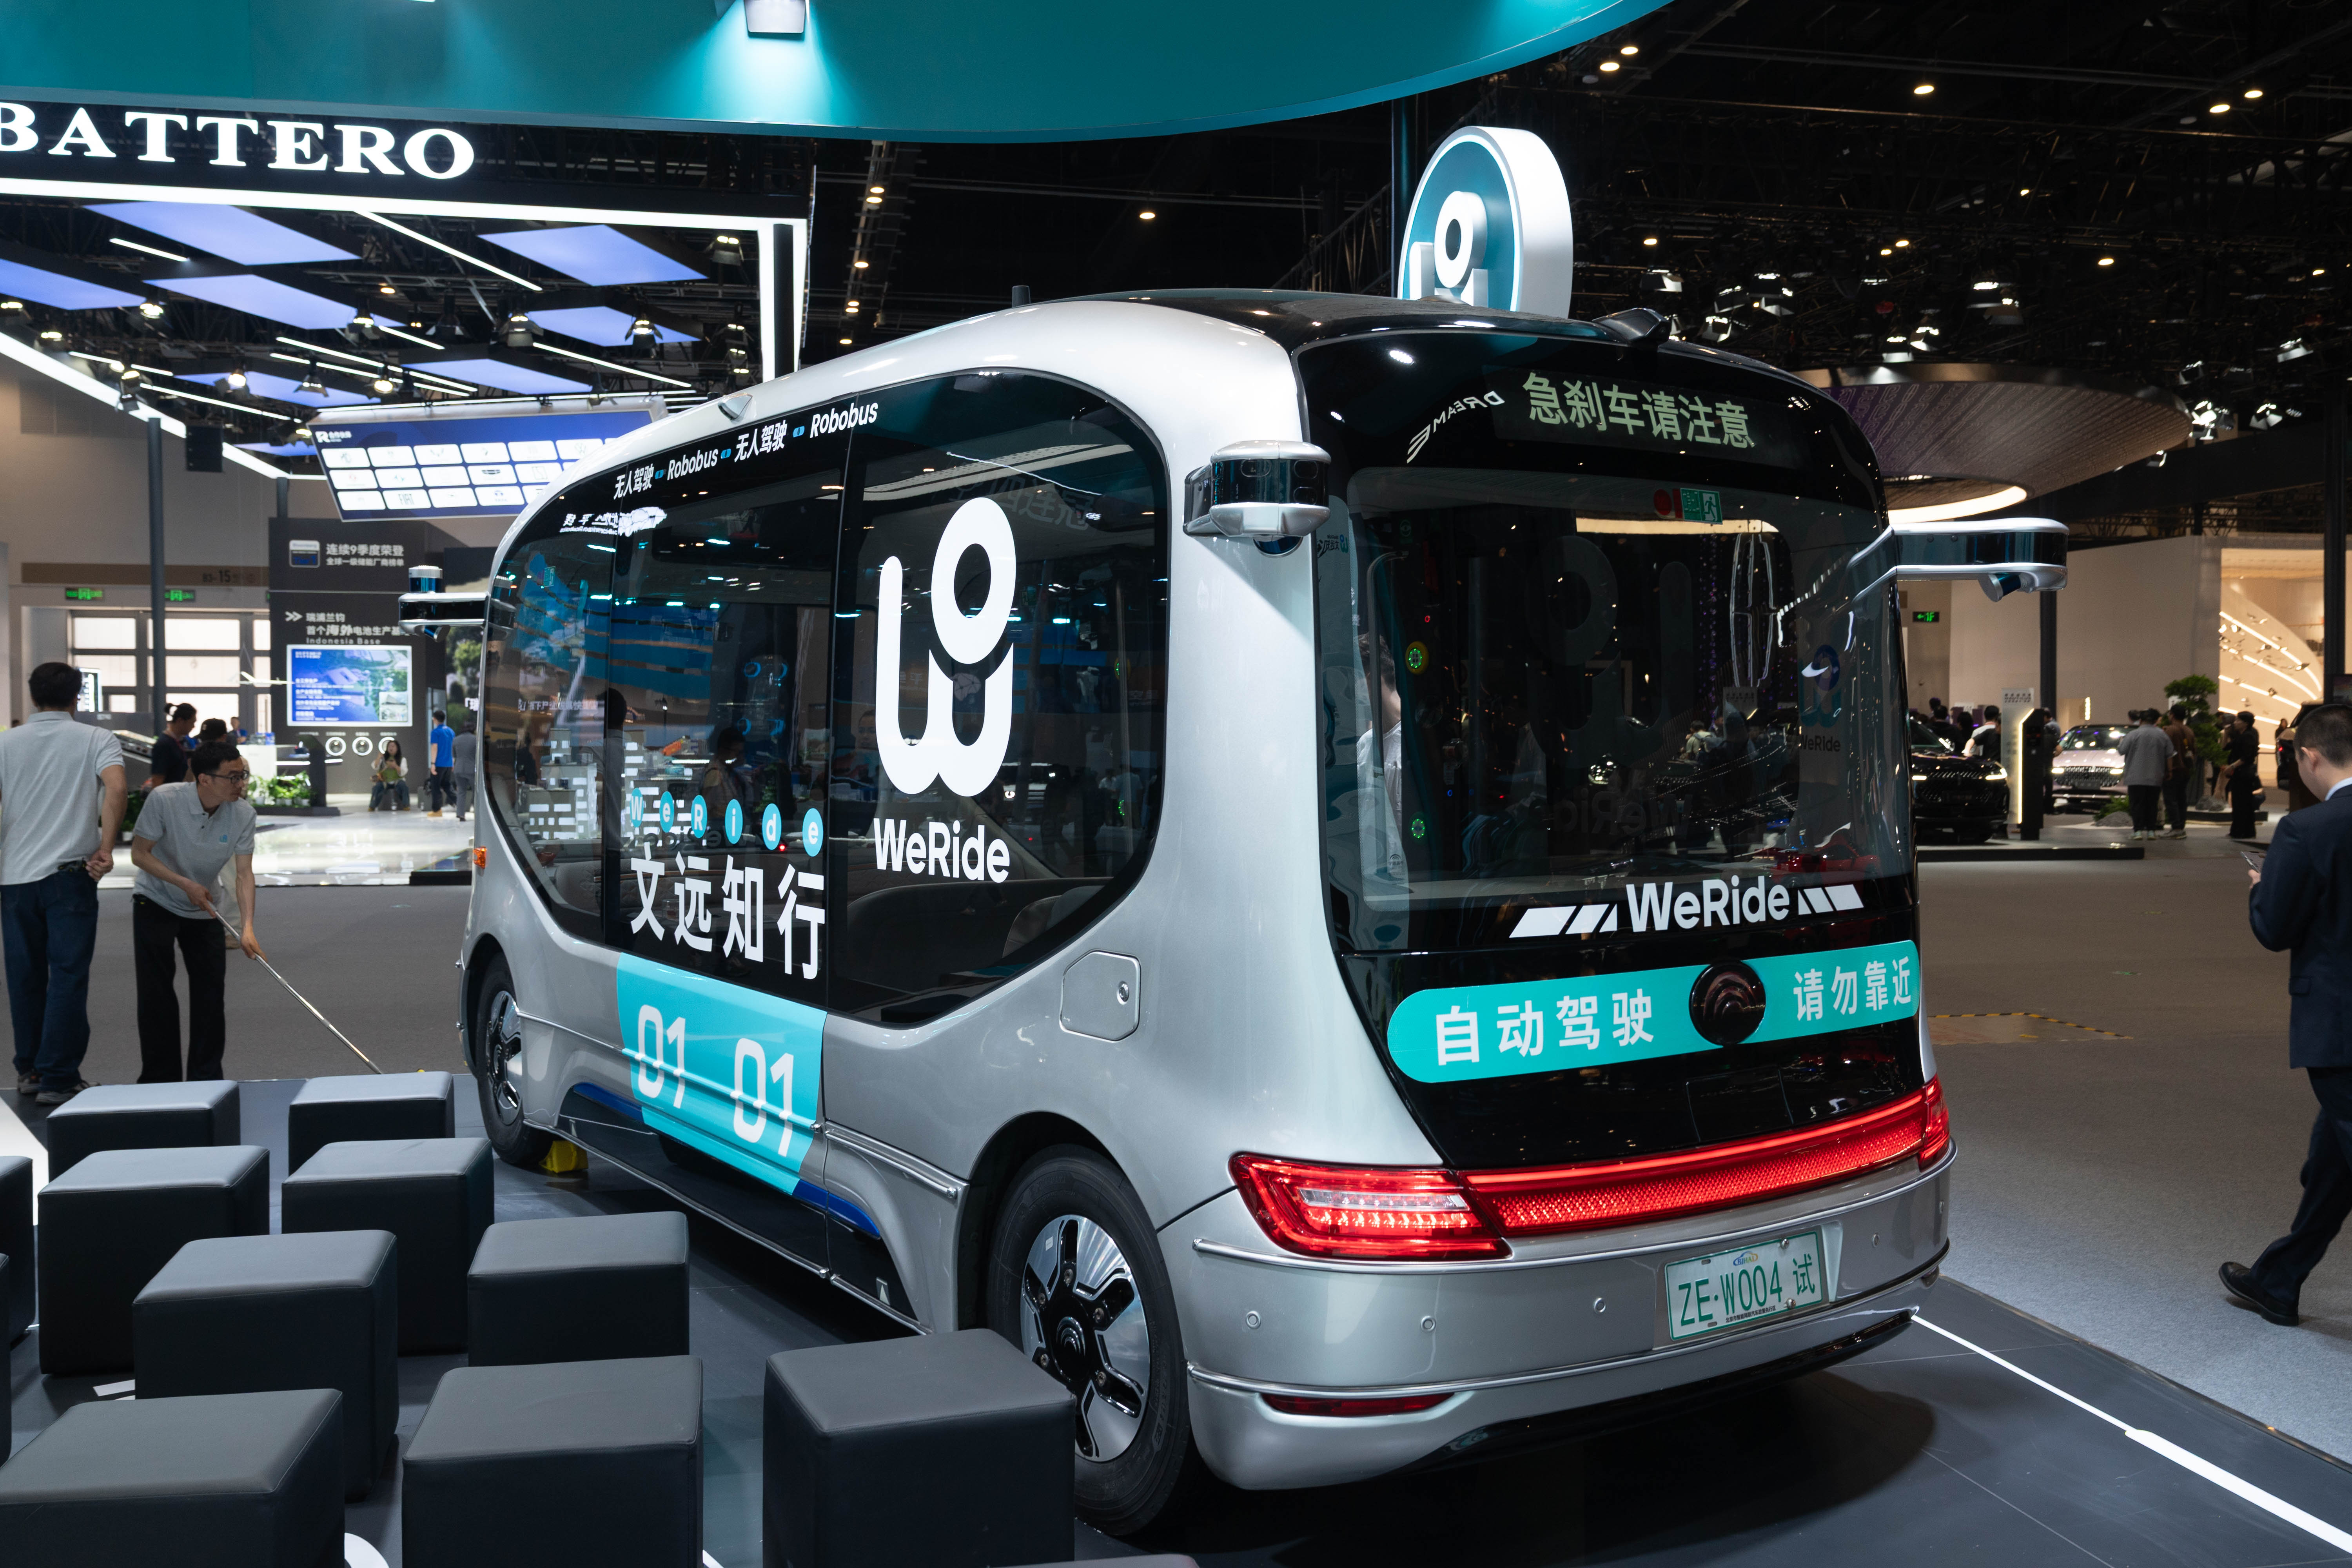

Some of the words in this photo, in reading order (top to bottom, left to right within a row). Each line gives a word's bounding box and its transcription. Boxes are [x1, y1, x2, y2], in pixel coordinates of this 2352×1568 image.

[0, 102, 475, 180] BATTERO
[1523, 372, 1755, 449] 急刹车请注意
[613, 463, 654, 500] 无人驾驶
[667, 448, 718, 481] Robobus
[734, 419, 788, 463] 无人驾驶
[810, 402, 878, 438] Robobus
[326, 543, 404, 557] 连续9季度荣登
[873, 818, 1010, 883] WeRide
[630, 842, 825, 980] 文远知行
[1625, 874, 1790, 933] WeRide
[1436, 988, 1653, 1066] 自动驾驶
[1793, 955, 1913, 1022] 请勿靠近
[637, 1005, 686, 1109] 01
[733, 1038, 794, 1157] 01
[1792, 1253, 1816, 1296] 试
